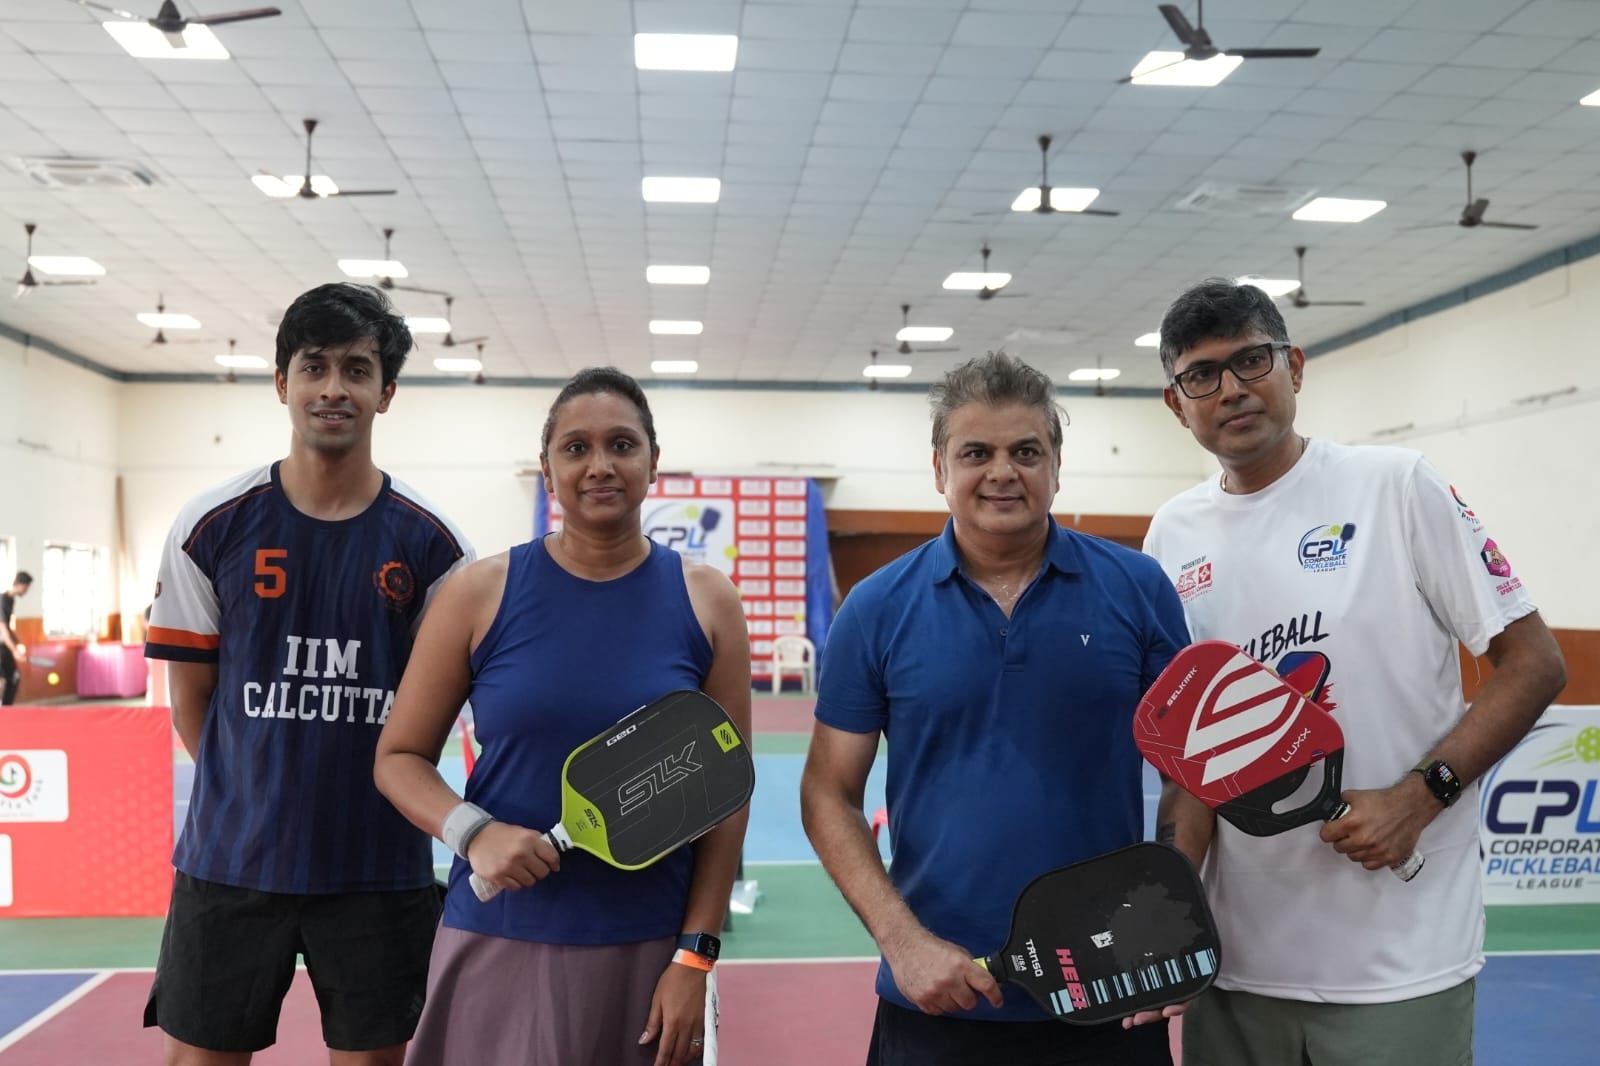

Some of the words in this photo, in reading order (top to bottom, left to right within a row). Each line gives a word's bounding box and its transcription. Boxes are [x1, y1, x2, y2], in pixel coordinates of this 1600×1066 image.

[1302, 539, 1347, 558] CPL
[1303, 554, 1346, 564] CORPORATE
[254, 549, 288, 598] 5
[1303, 560, 1347, 569] PICKLEBALL
[1080, 634, 1090, 647] V
[1236, 610, 1330, 663] LEBALL
[283, 635, 361, 679] IIM
[1166, 667, 1198, 707] SELKIRK
[243, 682, 396, 725] CALCUTTA
[606, 724, 637, 747] GEO
[1281, 727, 1312, 763] LUXX
[617, 741, 703, 816] SLK
[584, 808, 602, 829] SLK
[1486, 779, 1600, 835] CPL
[1490, 839, 1600, 855] CORPORAT
[1516, 877, 1584, 890] LEAGUE
[1017, 954, 1027, 971] USA
